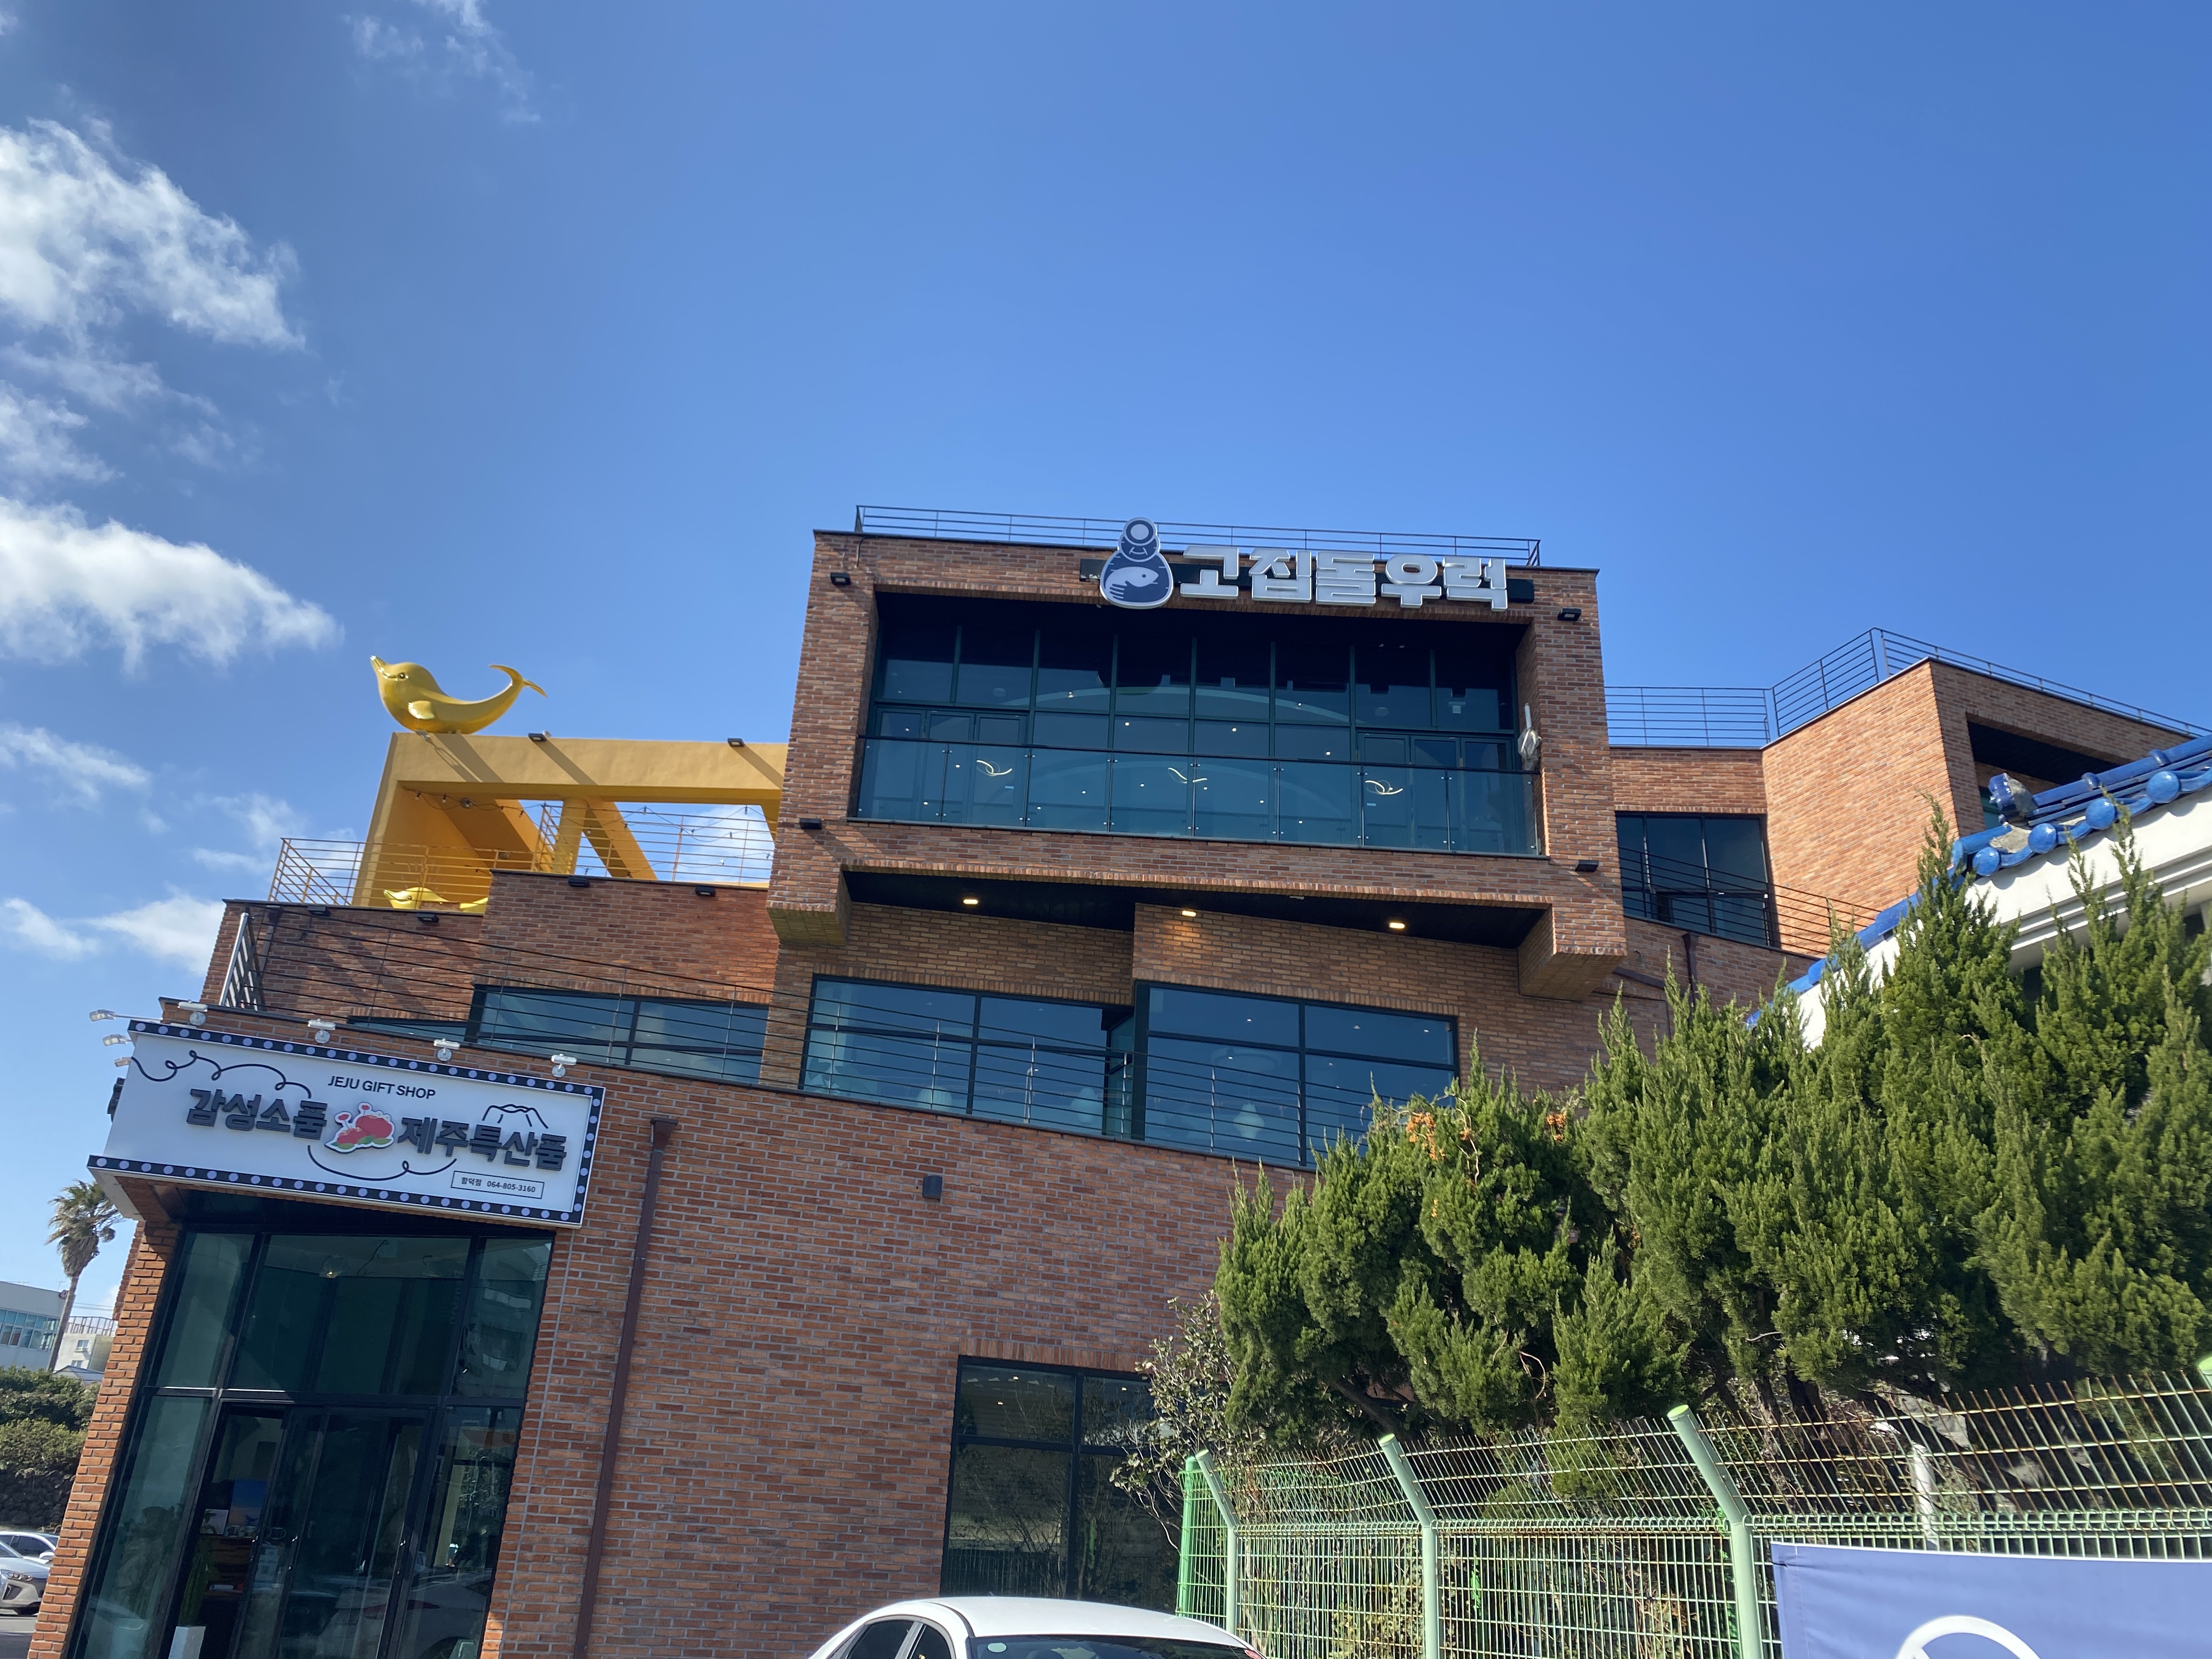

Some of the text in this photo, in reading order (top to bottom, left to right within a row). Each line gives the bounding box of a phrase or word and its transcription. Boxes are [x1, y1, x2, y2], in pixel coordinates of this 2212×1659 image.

[1181, 546, 1508, 611] 고집돌우럭
[328, 1075, 436, 1099] JEJU GIFT SHOP
[186, 1088, 567, 1171] 감성소품 제주특산품
[461, 1177, 535, 1193] 함덕점 064-805-3160
